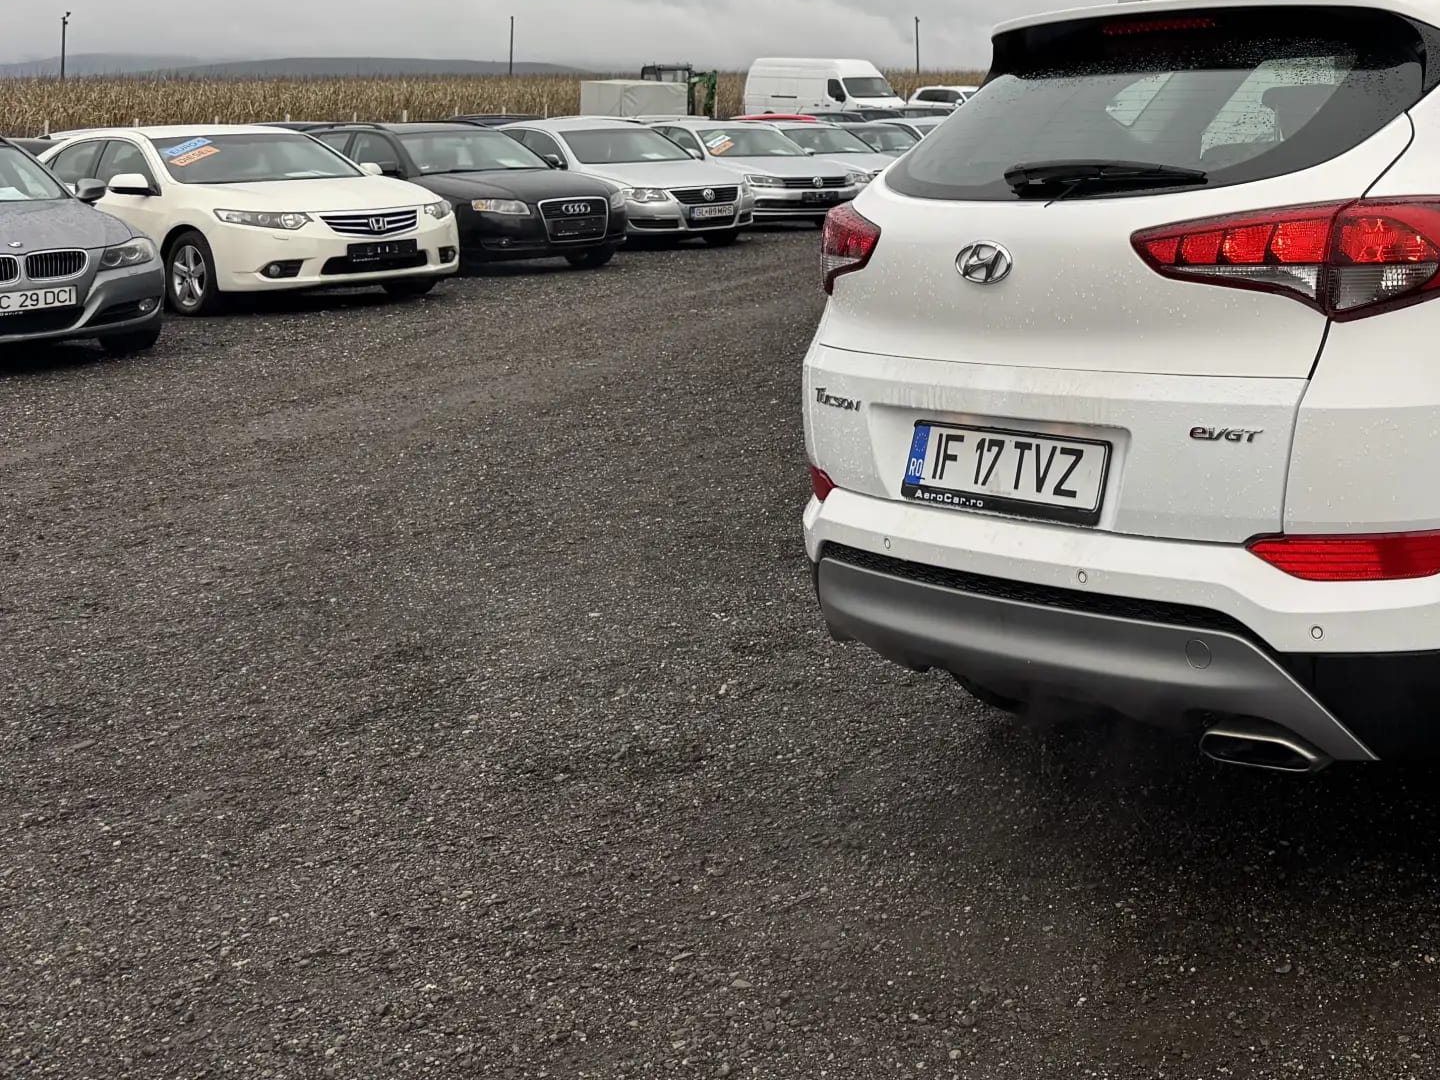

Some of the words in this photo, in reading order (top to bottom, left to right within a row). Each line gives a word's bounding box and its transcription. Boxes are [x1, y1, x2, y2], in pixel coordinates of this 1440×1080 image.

[19, 292, 39, 308] 29
[44, 288, 72, 306] DCI
[908, 458, 924, 477] RO
[932, 433, 964, 480] IF
[974, 437, 1005, 487] 17
[1013, 440, 1084, 498] TVZ
[914, 489, 984, 508] AeroCar.ro
